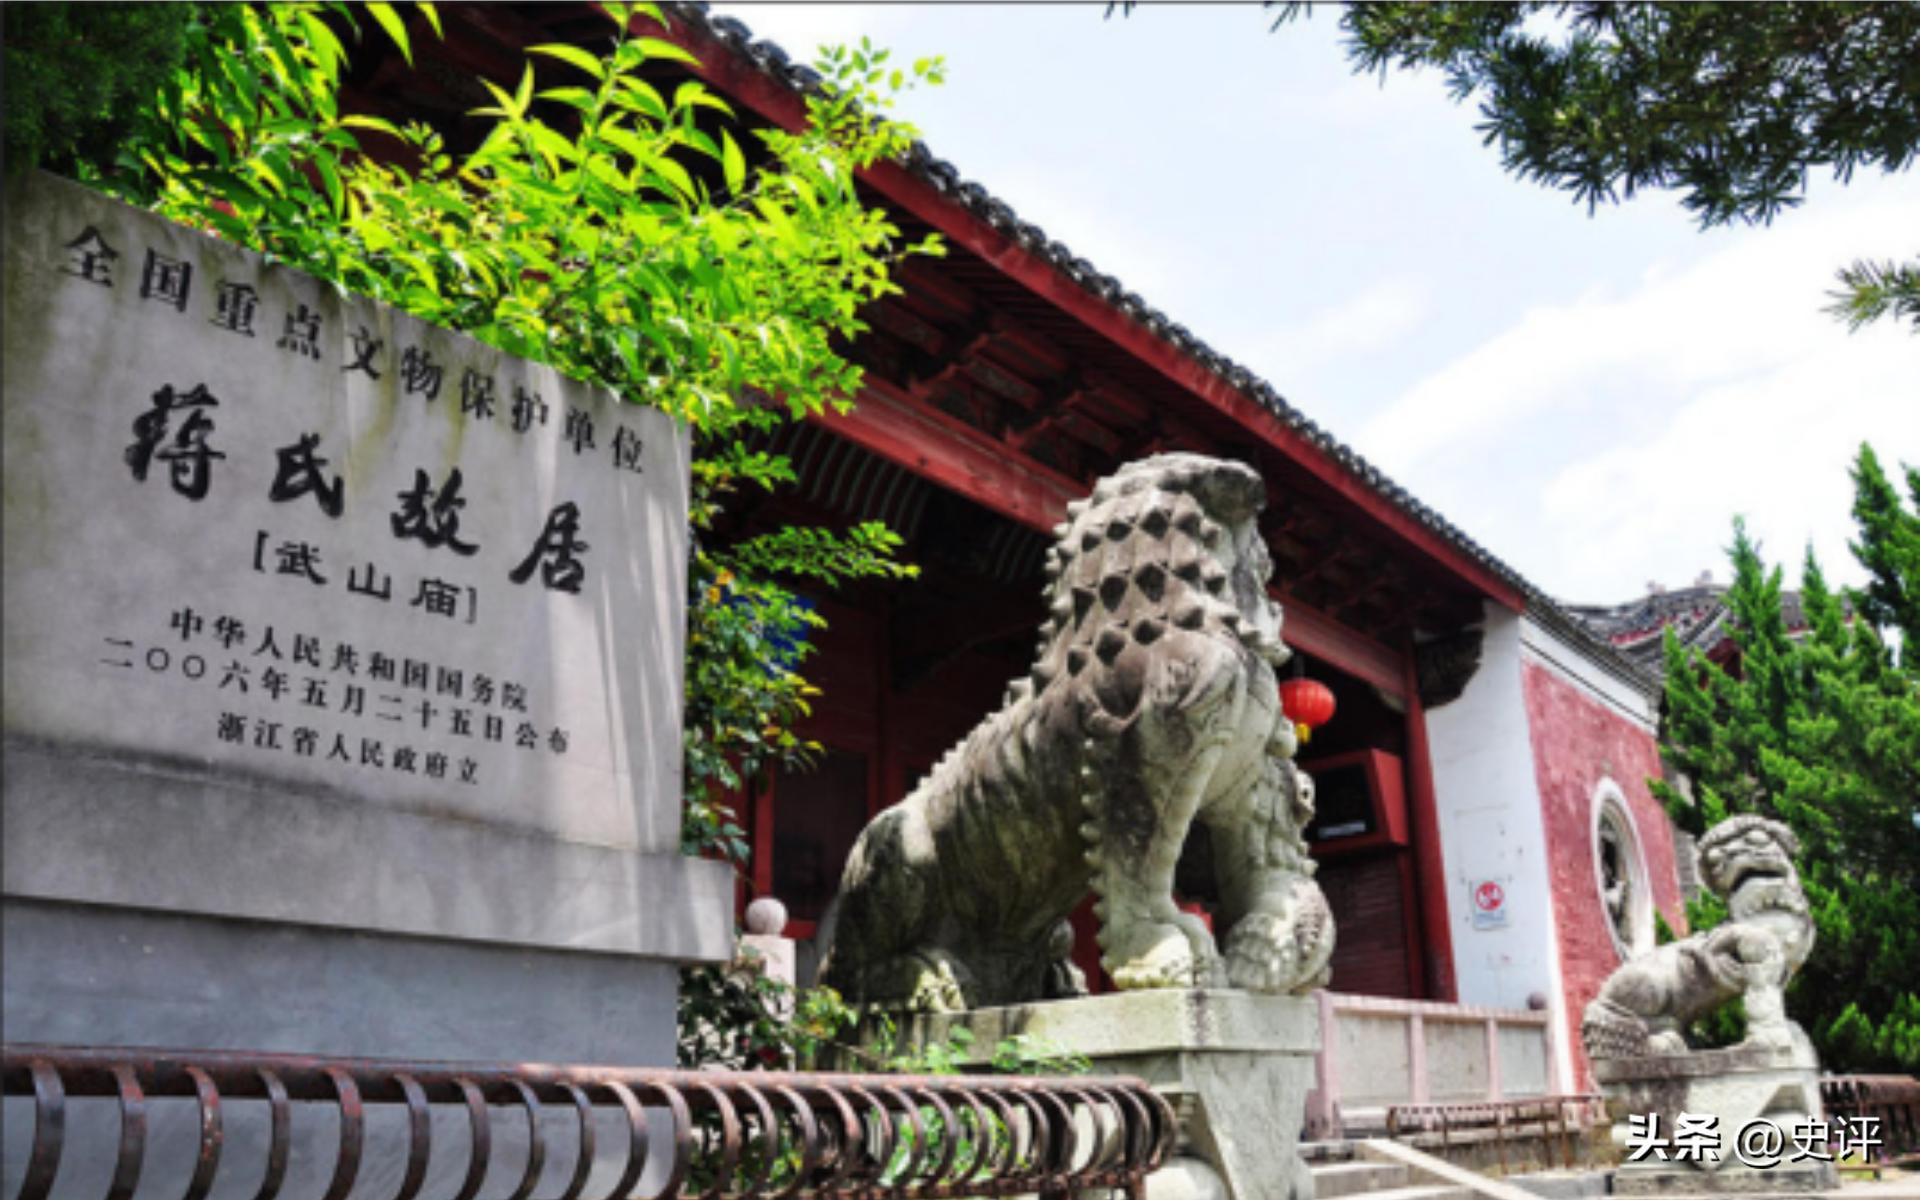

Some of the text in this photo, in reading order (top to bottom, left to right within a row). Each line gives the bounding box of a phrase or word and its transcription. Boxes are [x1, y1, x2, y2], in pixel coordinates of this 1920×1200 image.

[62, 225, 644, 475] 全国重点文物保护单位
[125, 383, 591, 595] 蒋氏故居
[169, 606, 529, 713] 中华人民共和国国务院
[217, 712, 480, 785] 浙江省人民政府立
